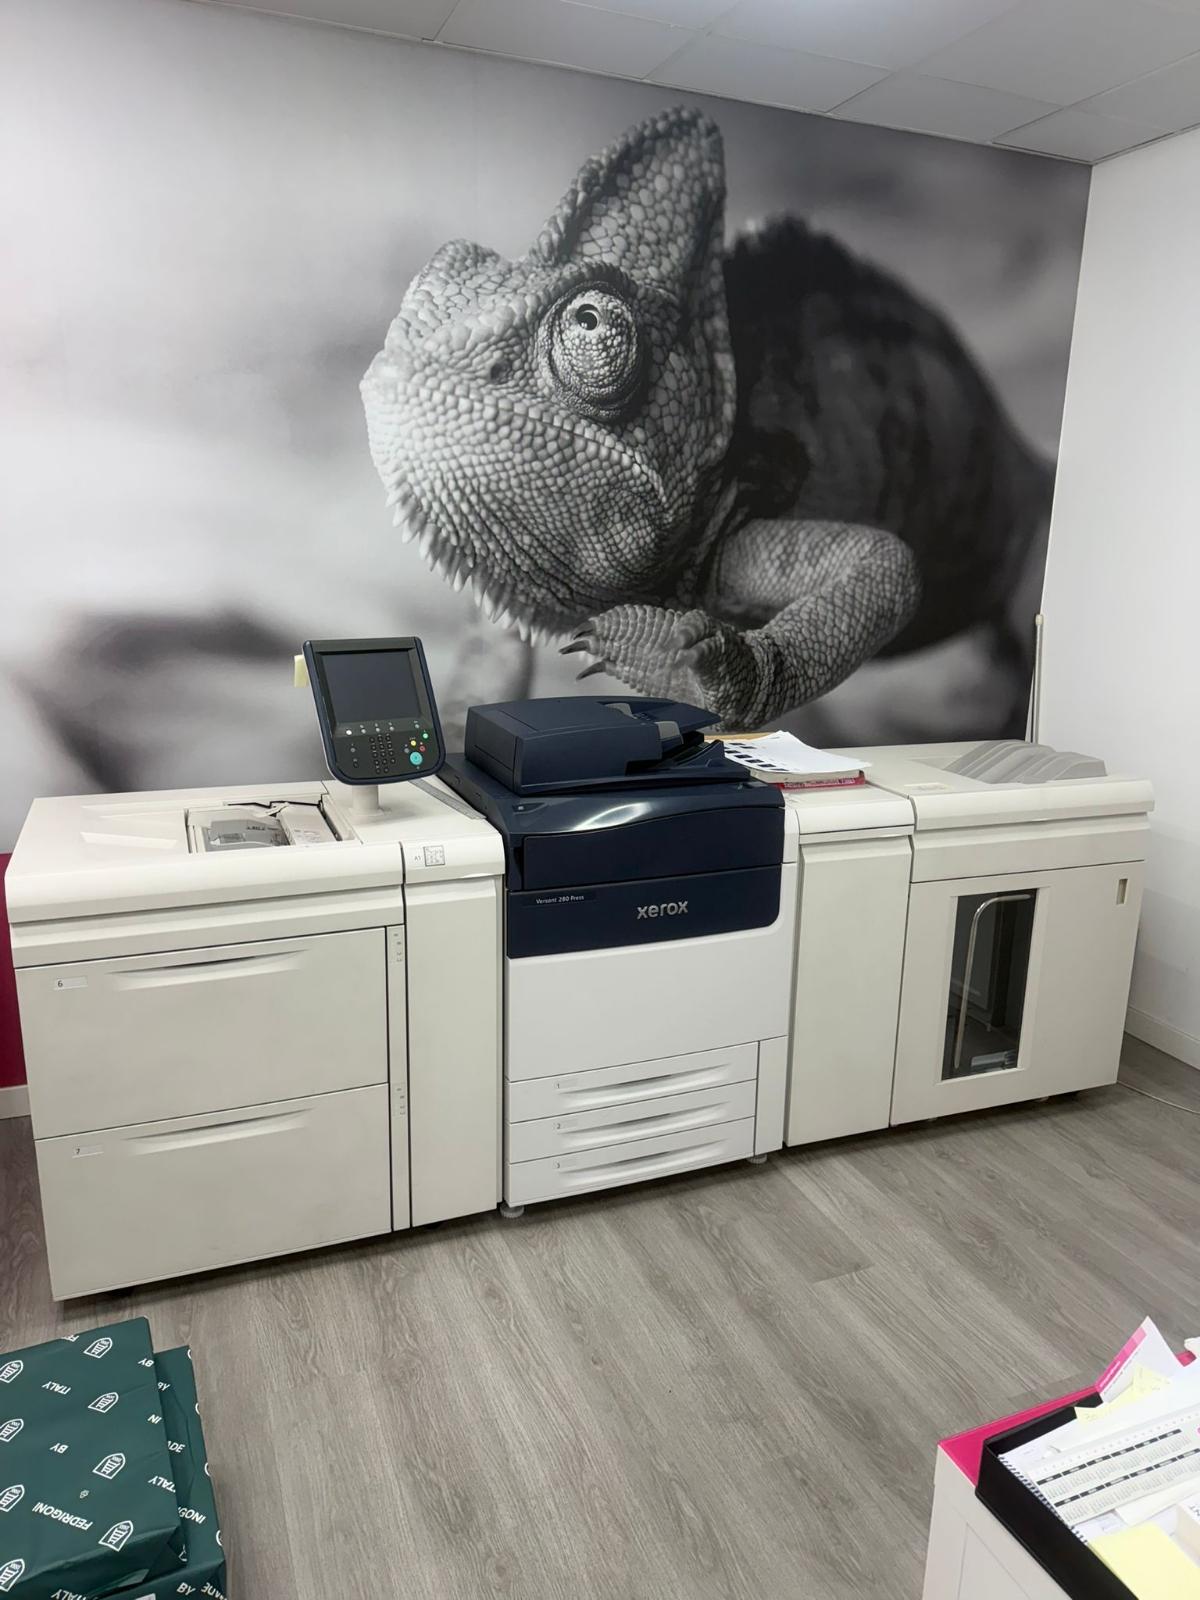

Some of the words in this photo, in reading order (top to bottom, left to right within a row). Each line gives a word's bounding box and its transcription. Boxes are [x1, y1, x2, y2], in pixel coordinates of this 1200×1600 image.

[636, 900, 689, 920] xerox
[57, 979, 64, 988] 6
[137, 1357, 155, 1368] BY
[41, 1380, 72, 1395] ITALY
[147, 1413, 163, 1424] IN
[49, 1442, 69, 1454] BY
[147, 1475, 176, 1493] TALY
[32, 1501, 94, 1531] FEDRIGONI
[176, 1582, 196, 1595] BY
